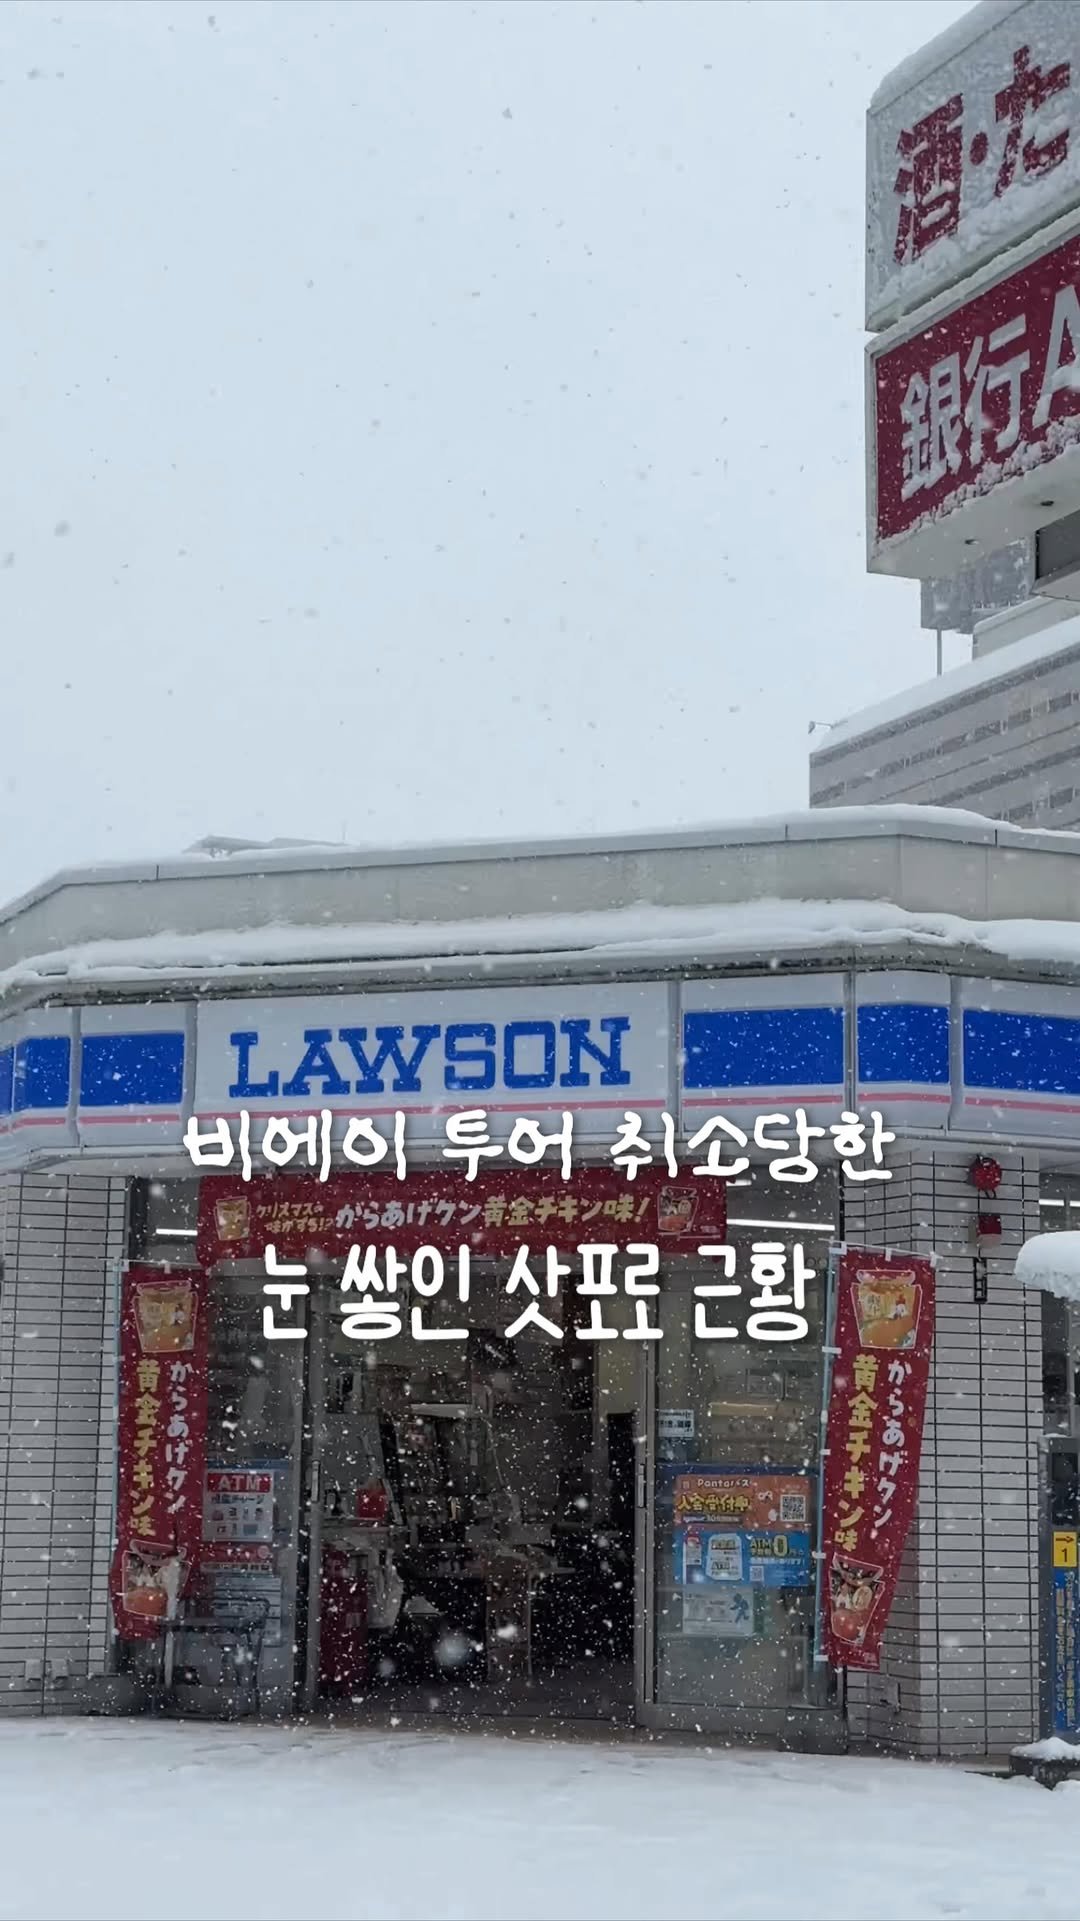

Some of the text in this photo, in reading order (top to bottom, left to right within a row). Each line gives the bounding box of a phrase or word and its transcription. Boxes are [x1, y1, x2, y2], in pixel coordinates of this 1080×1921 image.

[229, 1016, 631, 1098] LAWSON
[129, 1358, 162, 1537] 黄金チキン味
[164, 1359, 193, 1515] からあげクン
[218, 1474, 261, 1491] ATM
[834, 1354, 879, 1552] 黄金チキン味
[873, 1358, 912, 1530] からあげクン
[678, 1492, 750, 1512] 入会受付中
[1061, 1547, 1069, 1563] 1
